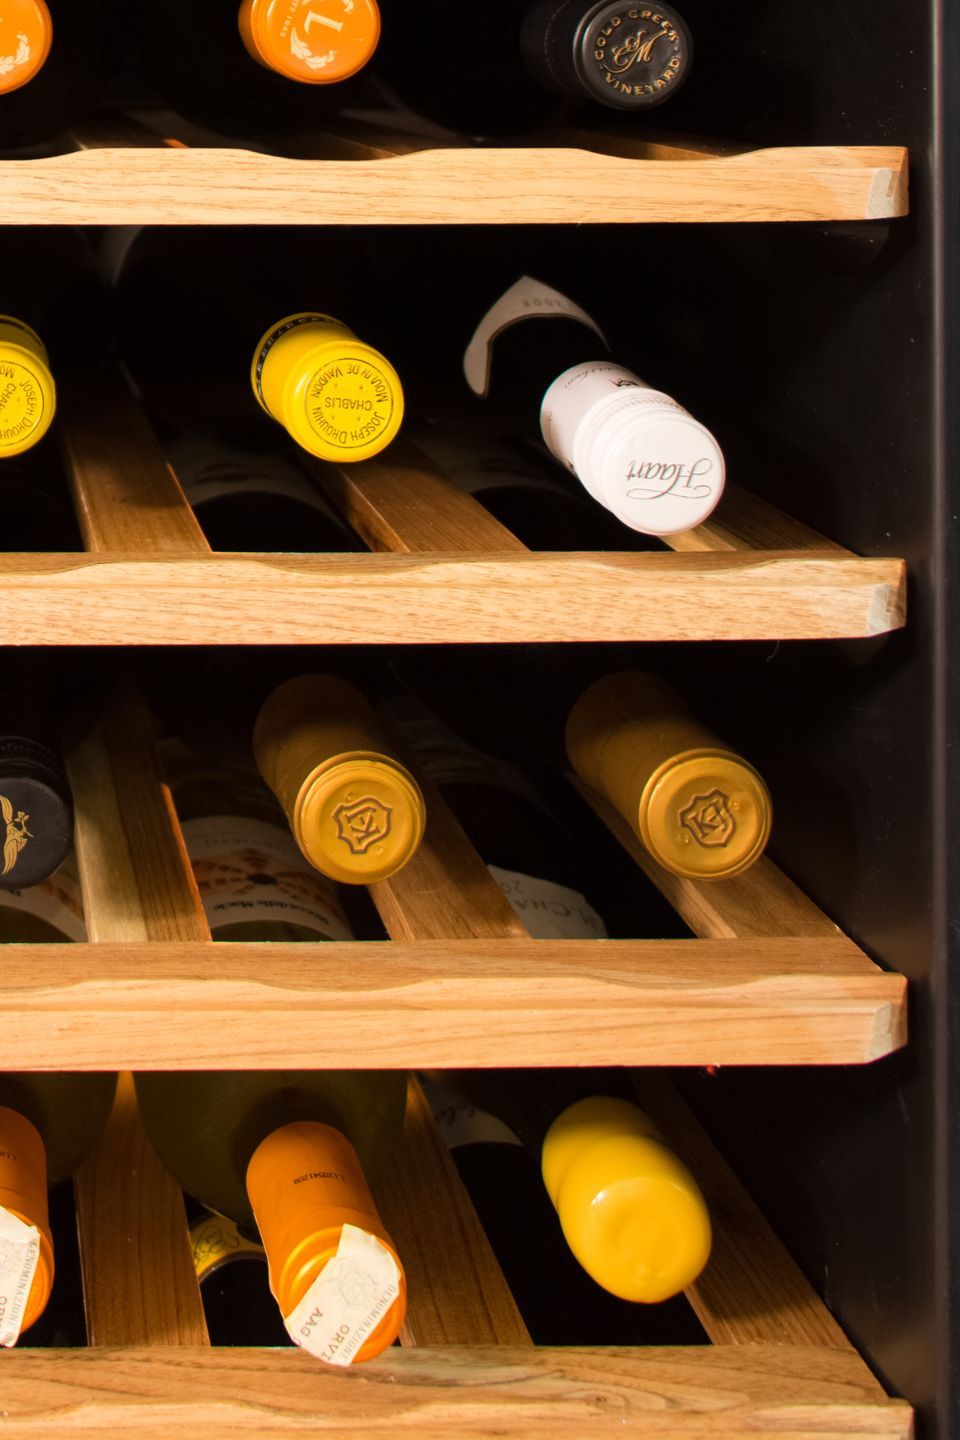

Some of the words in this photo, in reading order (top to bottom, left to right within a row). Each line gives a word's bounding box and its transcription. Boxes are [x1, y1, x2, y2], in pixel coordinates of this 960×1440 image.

[605, 55, 681, 96] VINEYARD
[19, 380, 38, 417] JOSEPH
[310, 366, 344, 399] VAUDON
[324, 396, 373, 412] CHABLIS
[311, 406, 349, 444] DROUHIN
[351, 411, 386, 442] JOSEPH
[300, 1306, 325, 1338] AAG
[341, 1283, 398, 1362] DENOMINAZIONE
